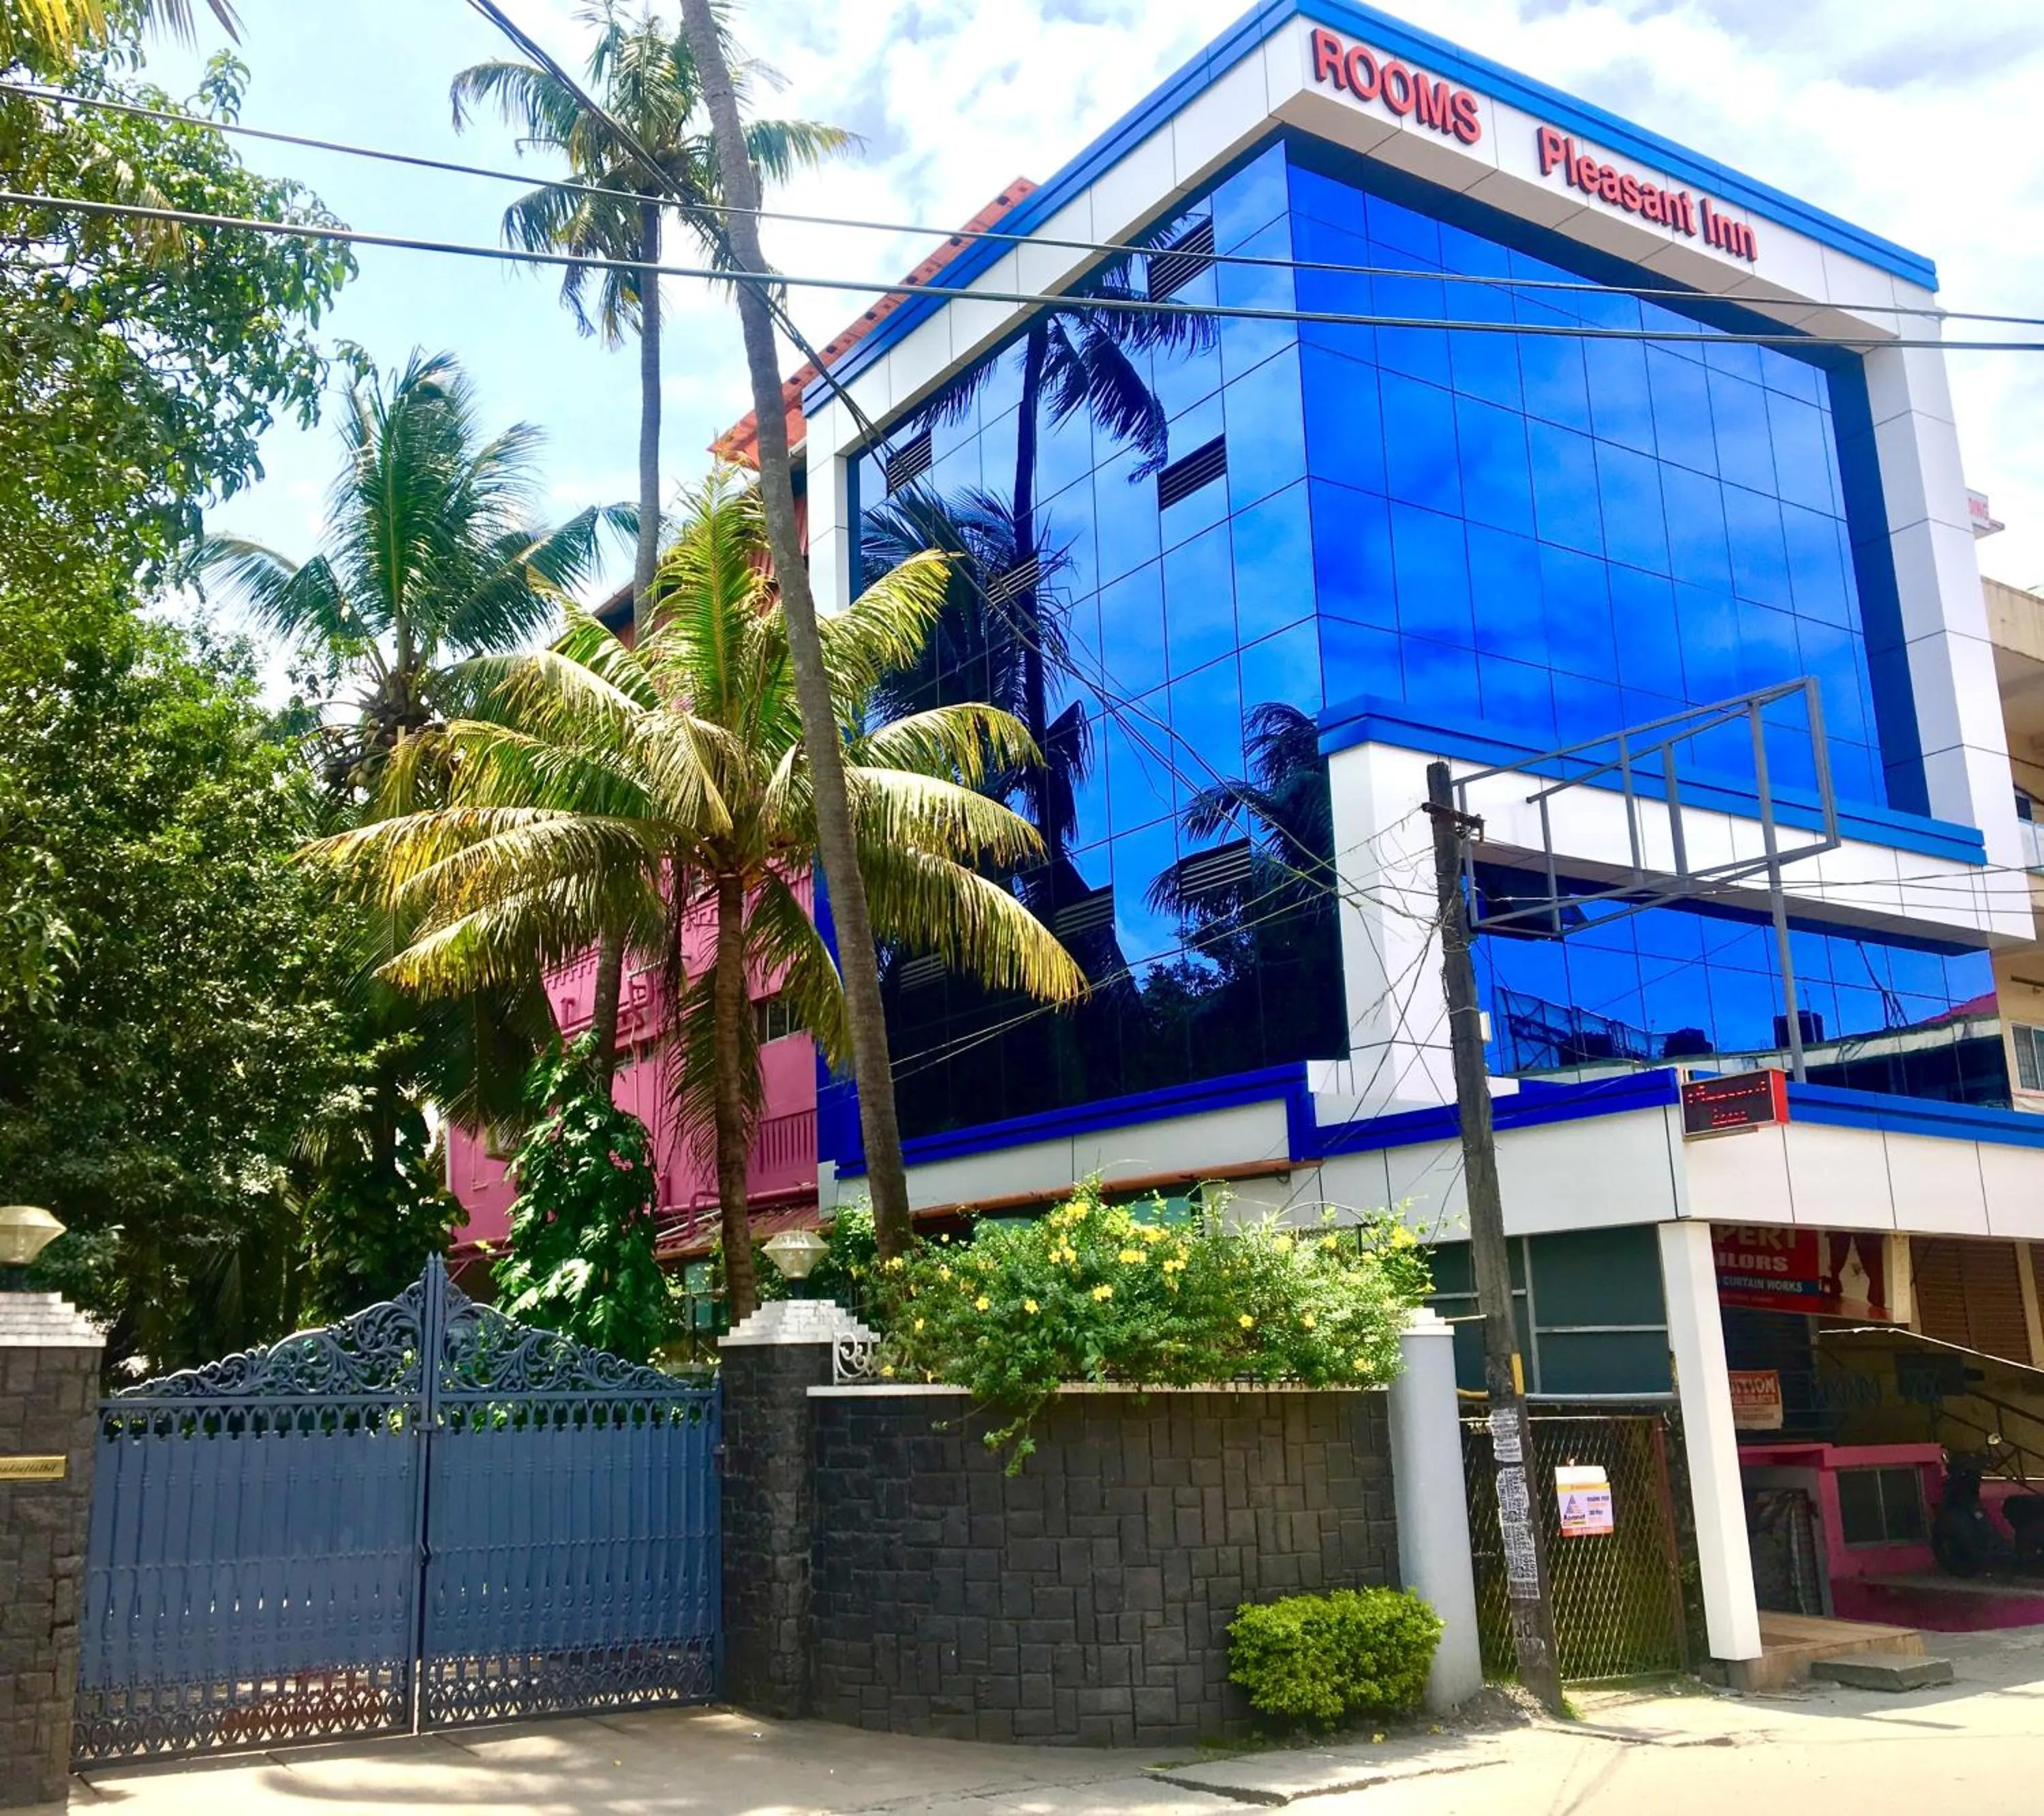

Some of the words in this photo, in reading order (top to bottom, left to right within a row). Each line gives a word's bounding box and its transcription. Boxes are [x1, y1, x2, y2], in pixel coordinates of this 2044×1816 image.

[1312, 28, 1482, 145] ROOMS
[1537, 126, 1697, 238] Pleasant
[1700, 197, 1759, 262] Inn
[1714, 1225, 1797, 1251] PERT
[1717, 1251, 1788, 1272] ILORS
[1722, 1275, 1765, 1289] CURTAIN
[1767, 1279, 1803, 1294] WORKS
